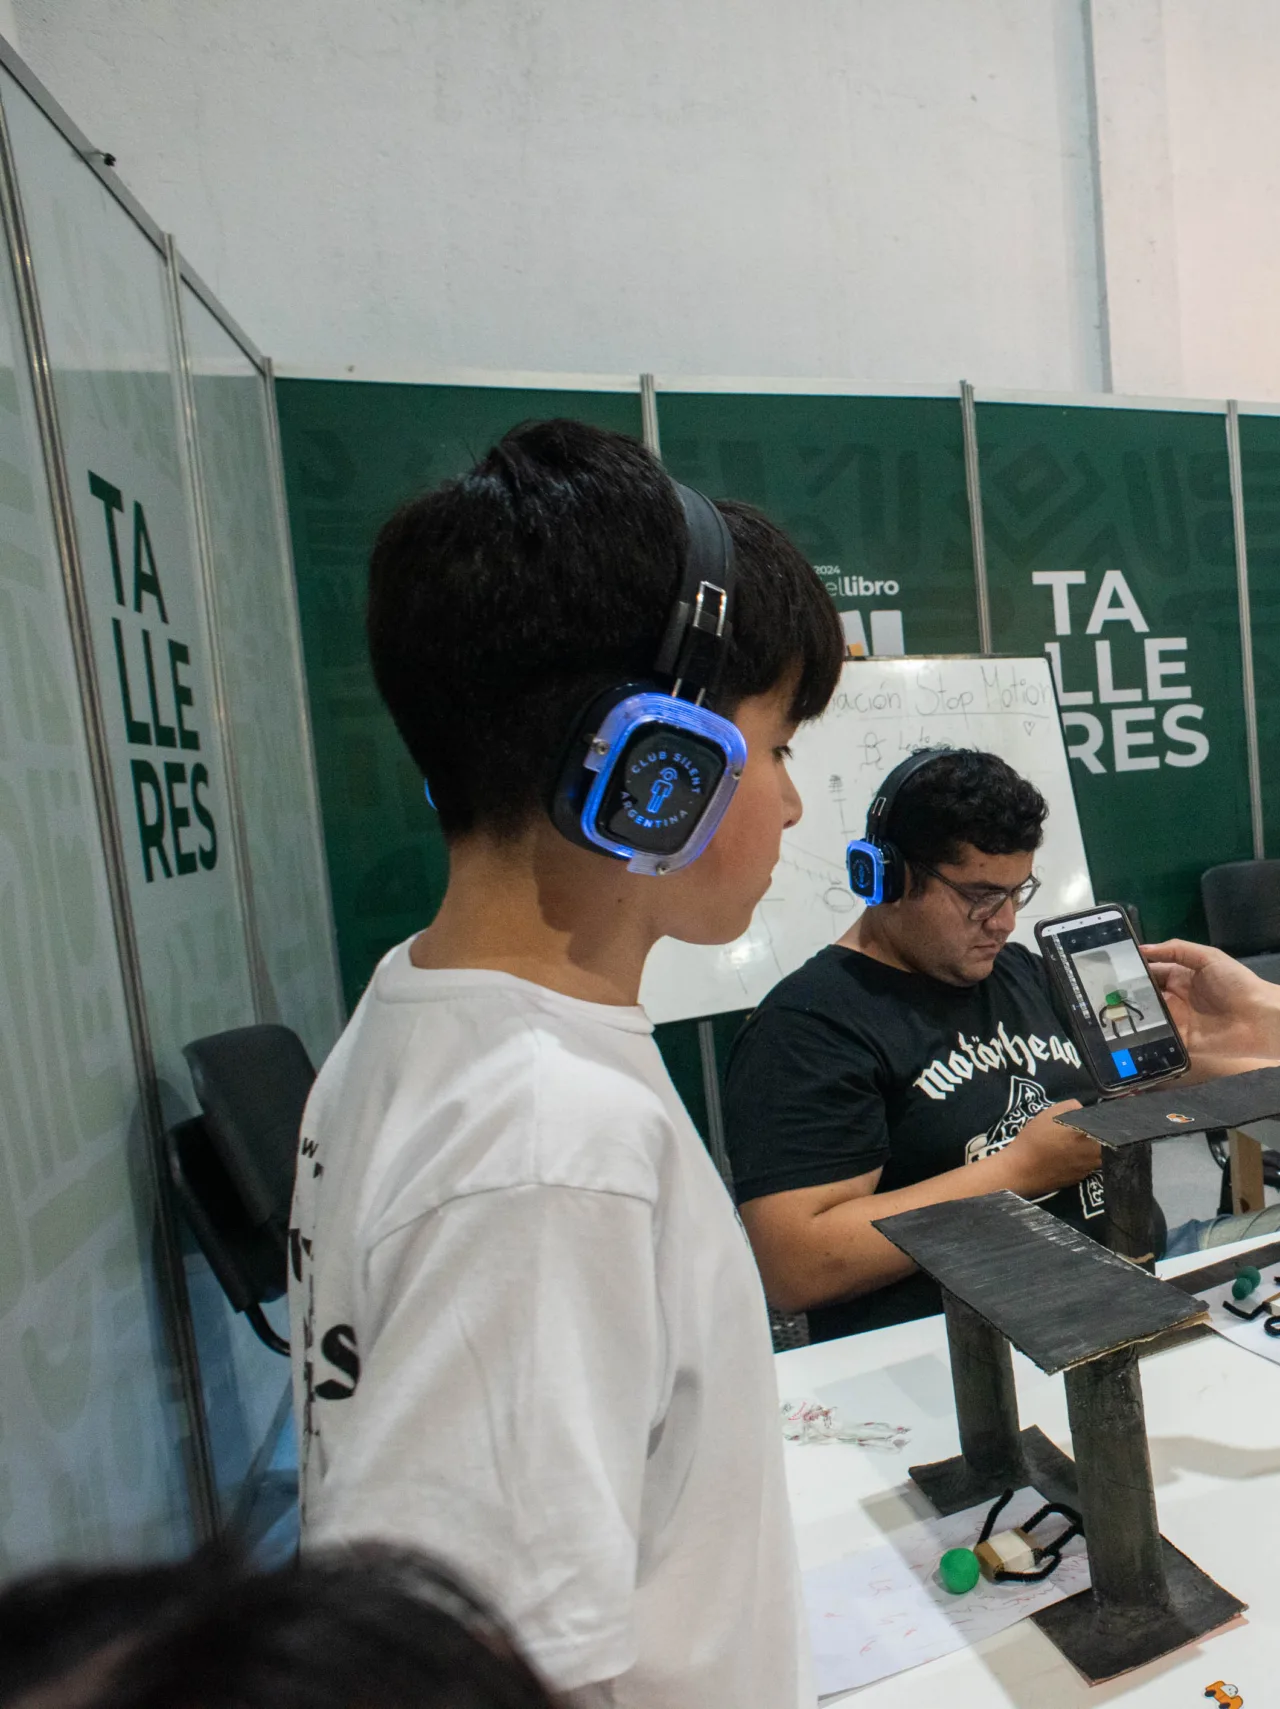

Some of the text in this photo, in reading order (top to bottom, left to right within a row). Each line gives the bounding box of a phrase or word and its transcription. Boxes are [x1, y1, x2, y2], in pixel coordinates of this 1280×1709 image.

[88, 470, 169, 624] TA
[814, 565, 840, 575] 2024
[821, 576, 899, 596] ellibro
[1032, 570, 1150, 636] TA
[112, 617, 200, 751] LLE
[832, 665, 1054, 729] ación Stop Motion
[1044, 637, 1192, 706] LLE
[631, 751, 701, 794] CLUB SILENT
[1061, 704, 1210, 775] RES
[130, 758, 218, 884] RES
[621, 791, 688, 828] ARGENTINA
